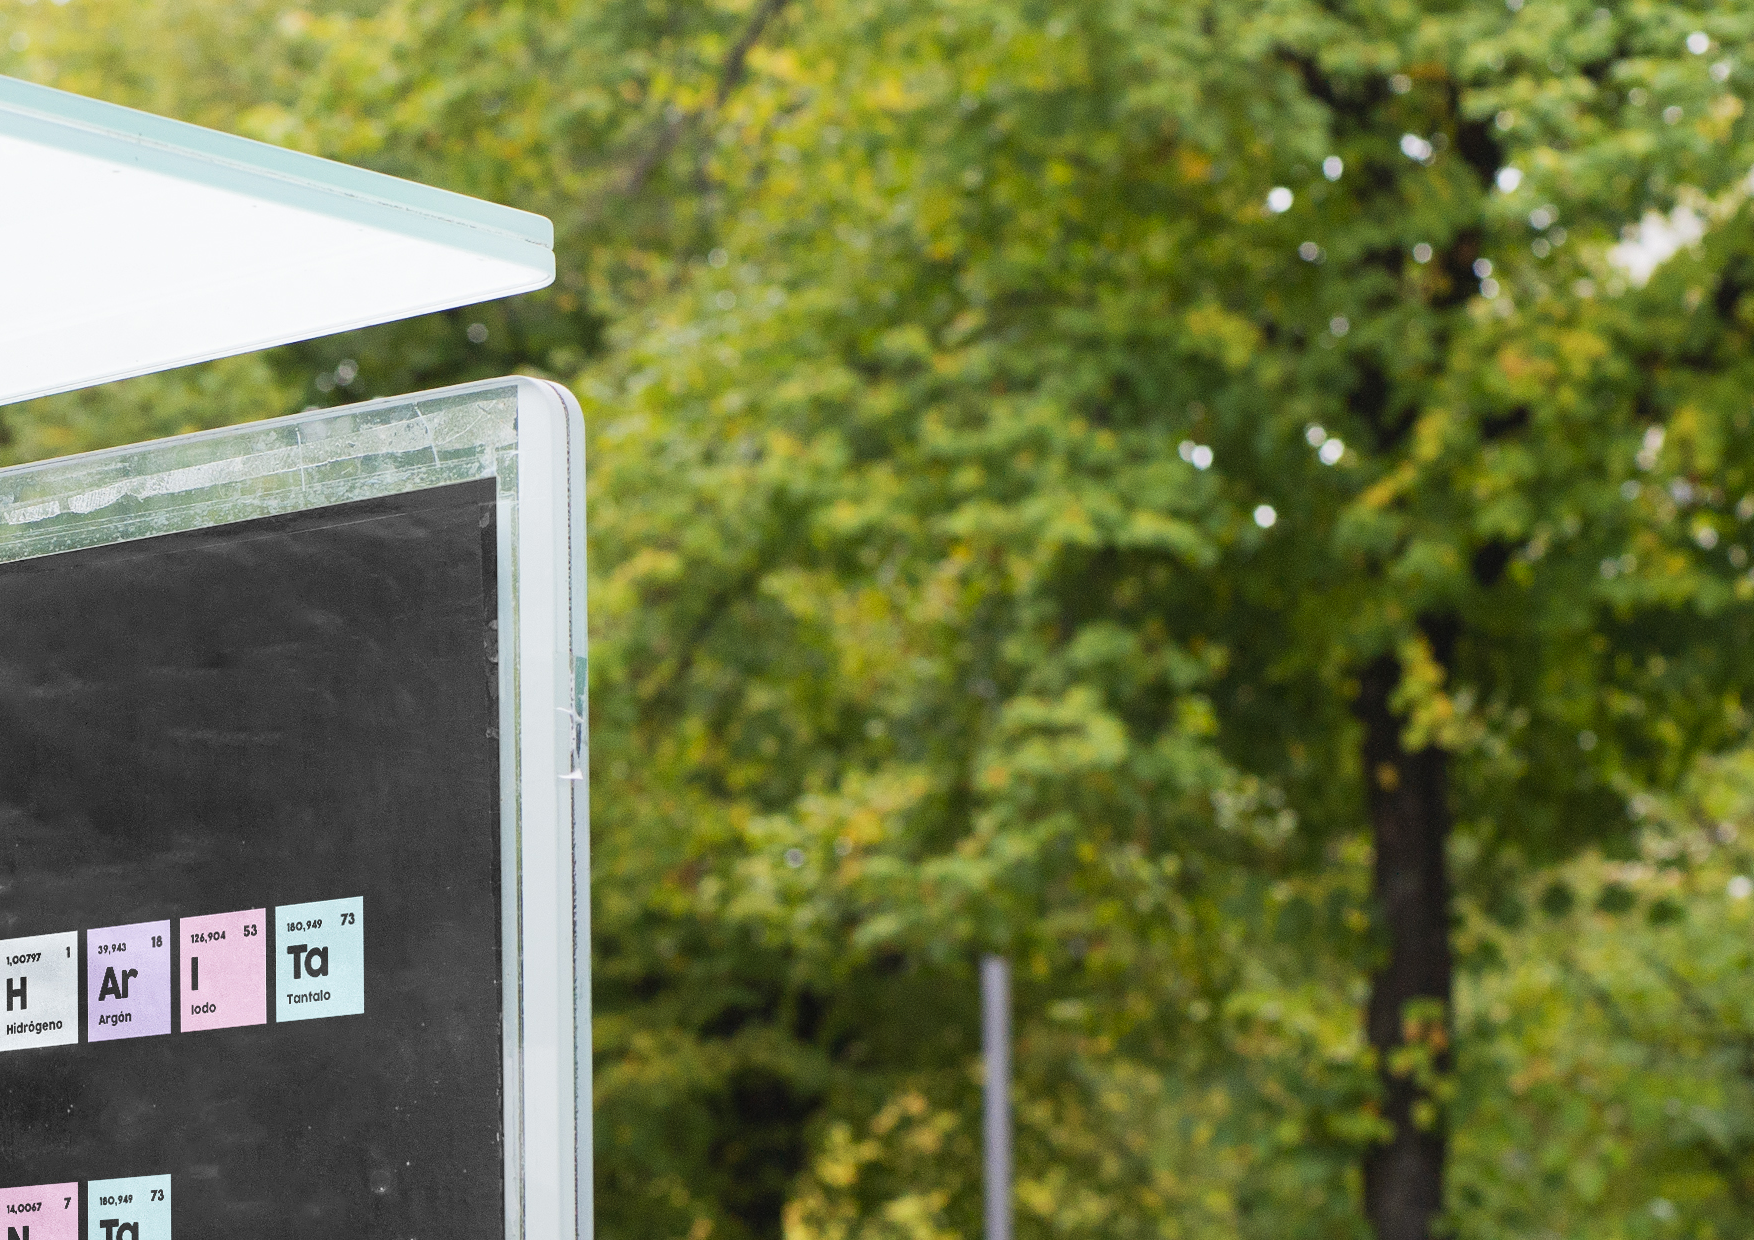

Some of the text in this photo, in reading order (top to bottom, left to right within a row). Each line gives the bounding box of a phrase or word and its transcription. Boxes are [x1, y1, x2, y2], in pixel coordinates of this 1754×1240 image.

[287, 919, 322, 932] 180,949
[341, 913, 355, 925] 73
[191, 931, 225, 943] 126,904
[244, 924, 257, 937] 53
[151, 936, 162, 947] 18
[98, 943, 126, 955] 39,943
[7, 953, 41, 966] 1,00797
[287, 944, 328, 979] Ta
[98, 967, 138, 1001] Ar
[7, 977, 27, 1011] H
[287, 990, 330, 1004] Tantalo
[99, 1013, 131, 1026] Argón
[7, 1021, 62, 1035] Hidrógeno
[100, 1195, 133, 1206] 180,949
[151, 1189, 164, 1201] 73
[7, 1202, 42, 1214] 14,0067
